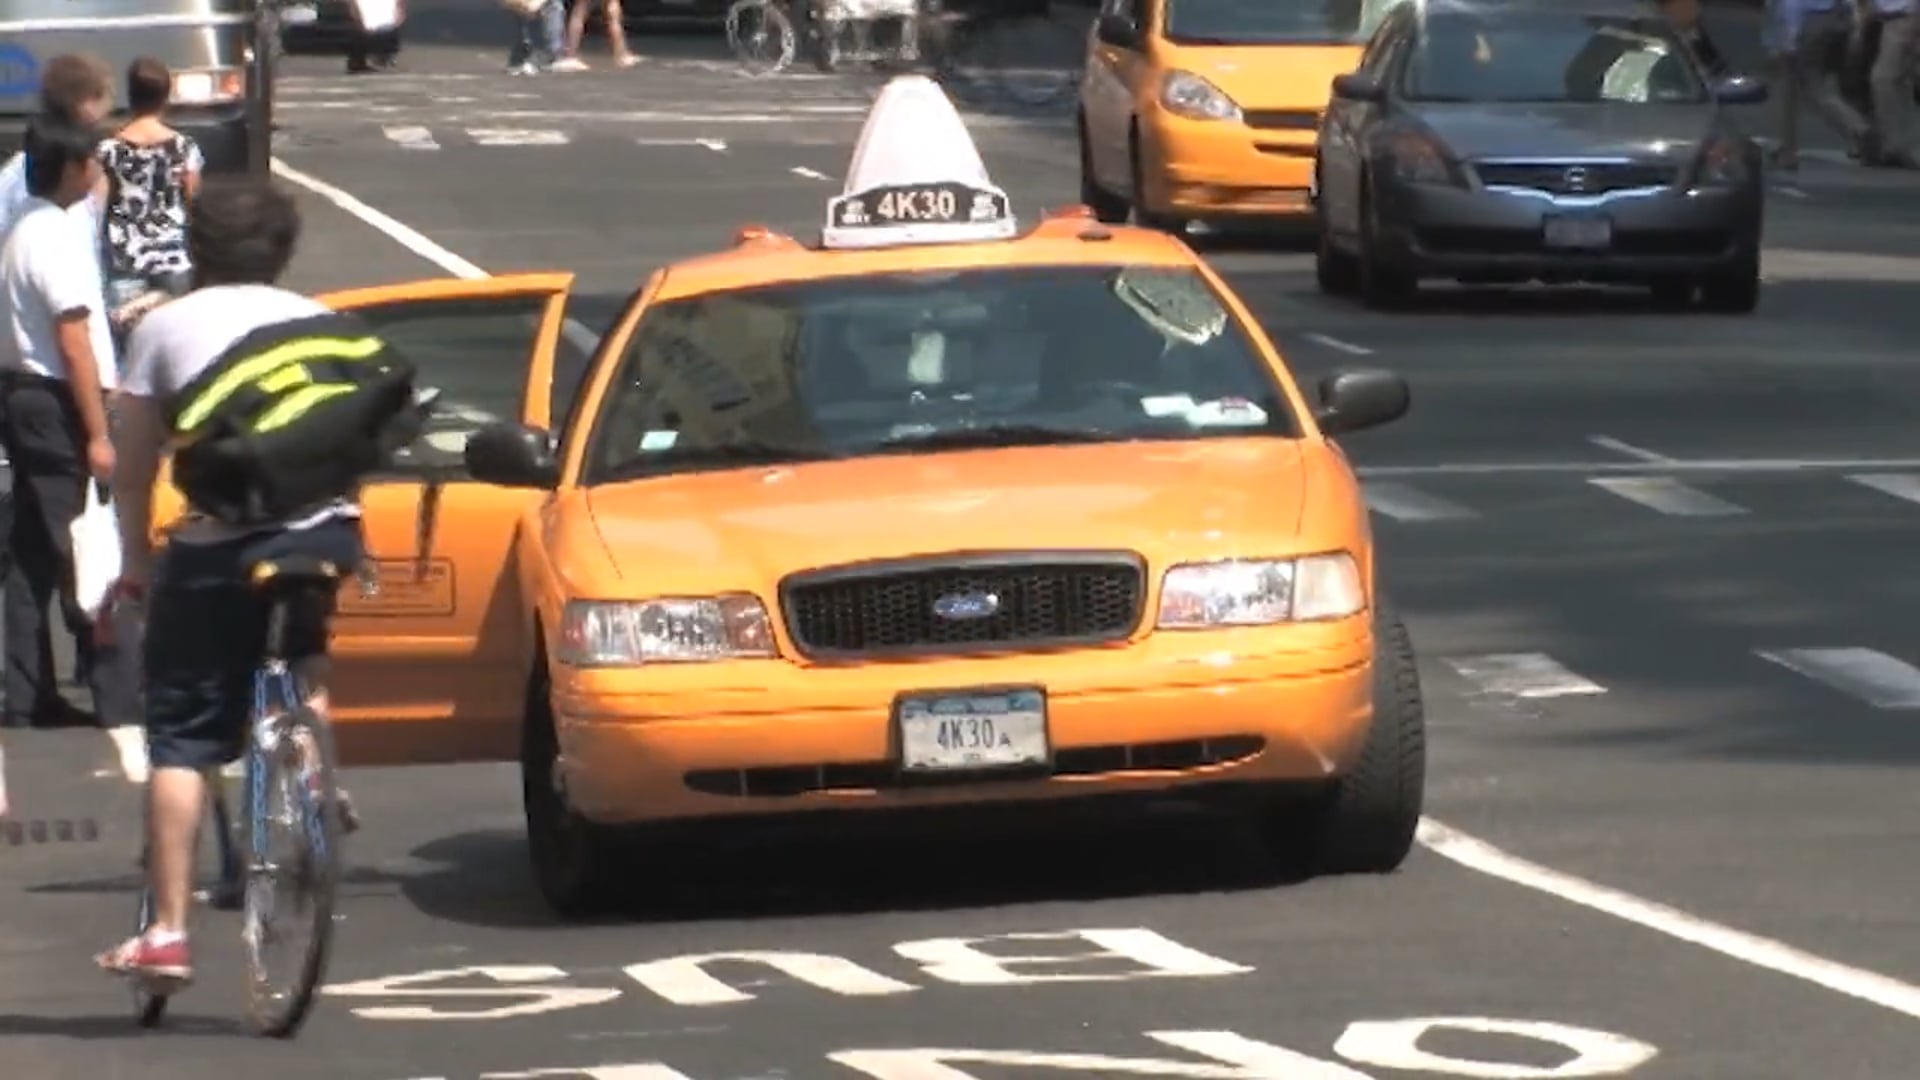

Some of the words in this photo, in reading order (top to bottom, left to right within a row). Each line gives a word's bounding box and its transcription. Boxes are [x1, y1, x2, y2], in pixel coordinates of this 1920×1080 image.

[877, 189, 956, 219] 4K30
[321, 928, 1254, 1019] BUS
[406, 1015, 1660, 1080] ON
